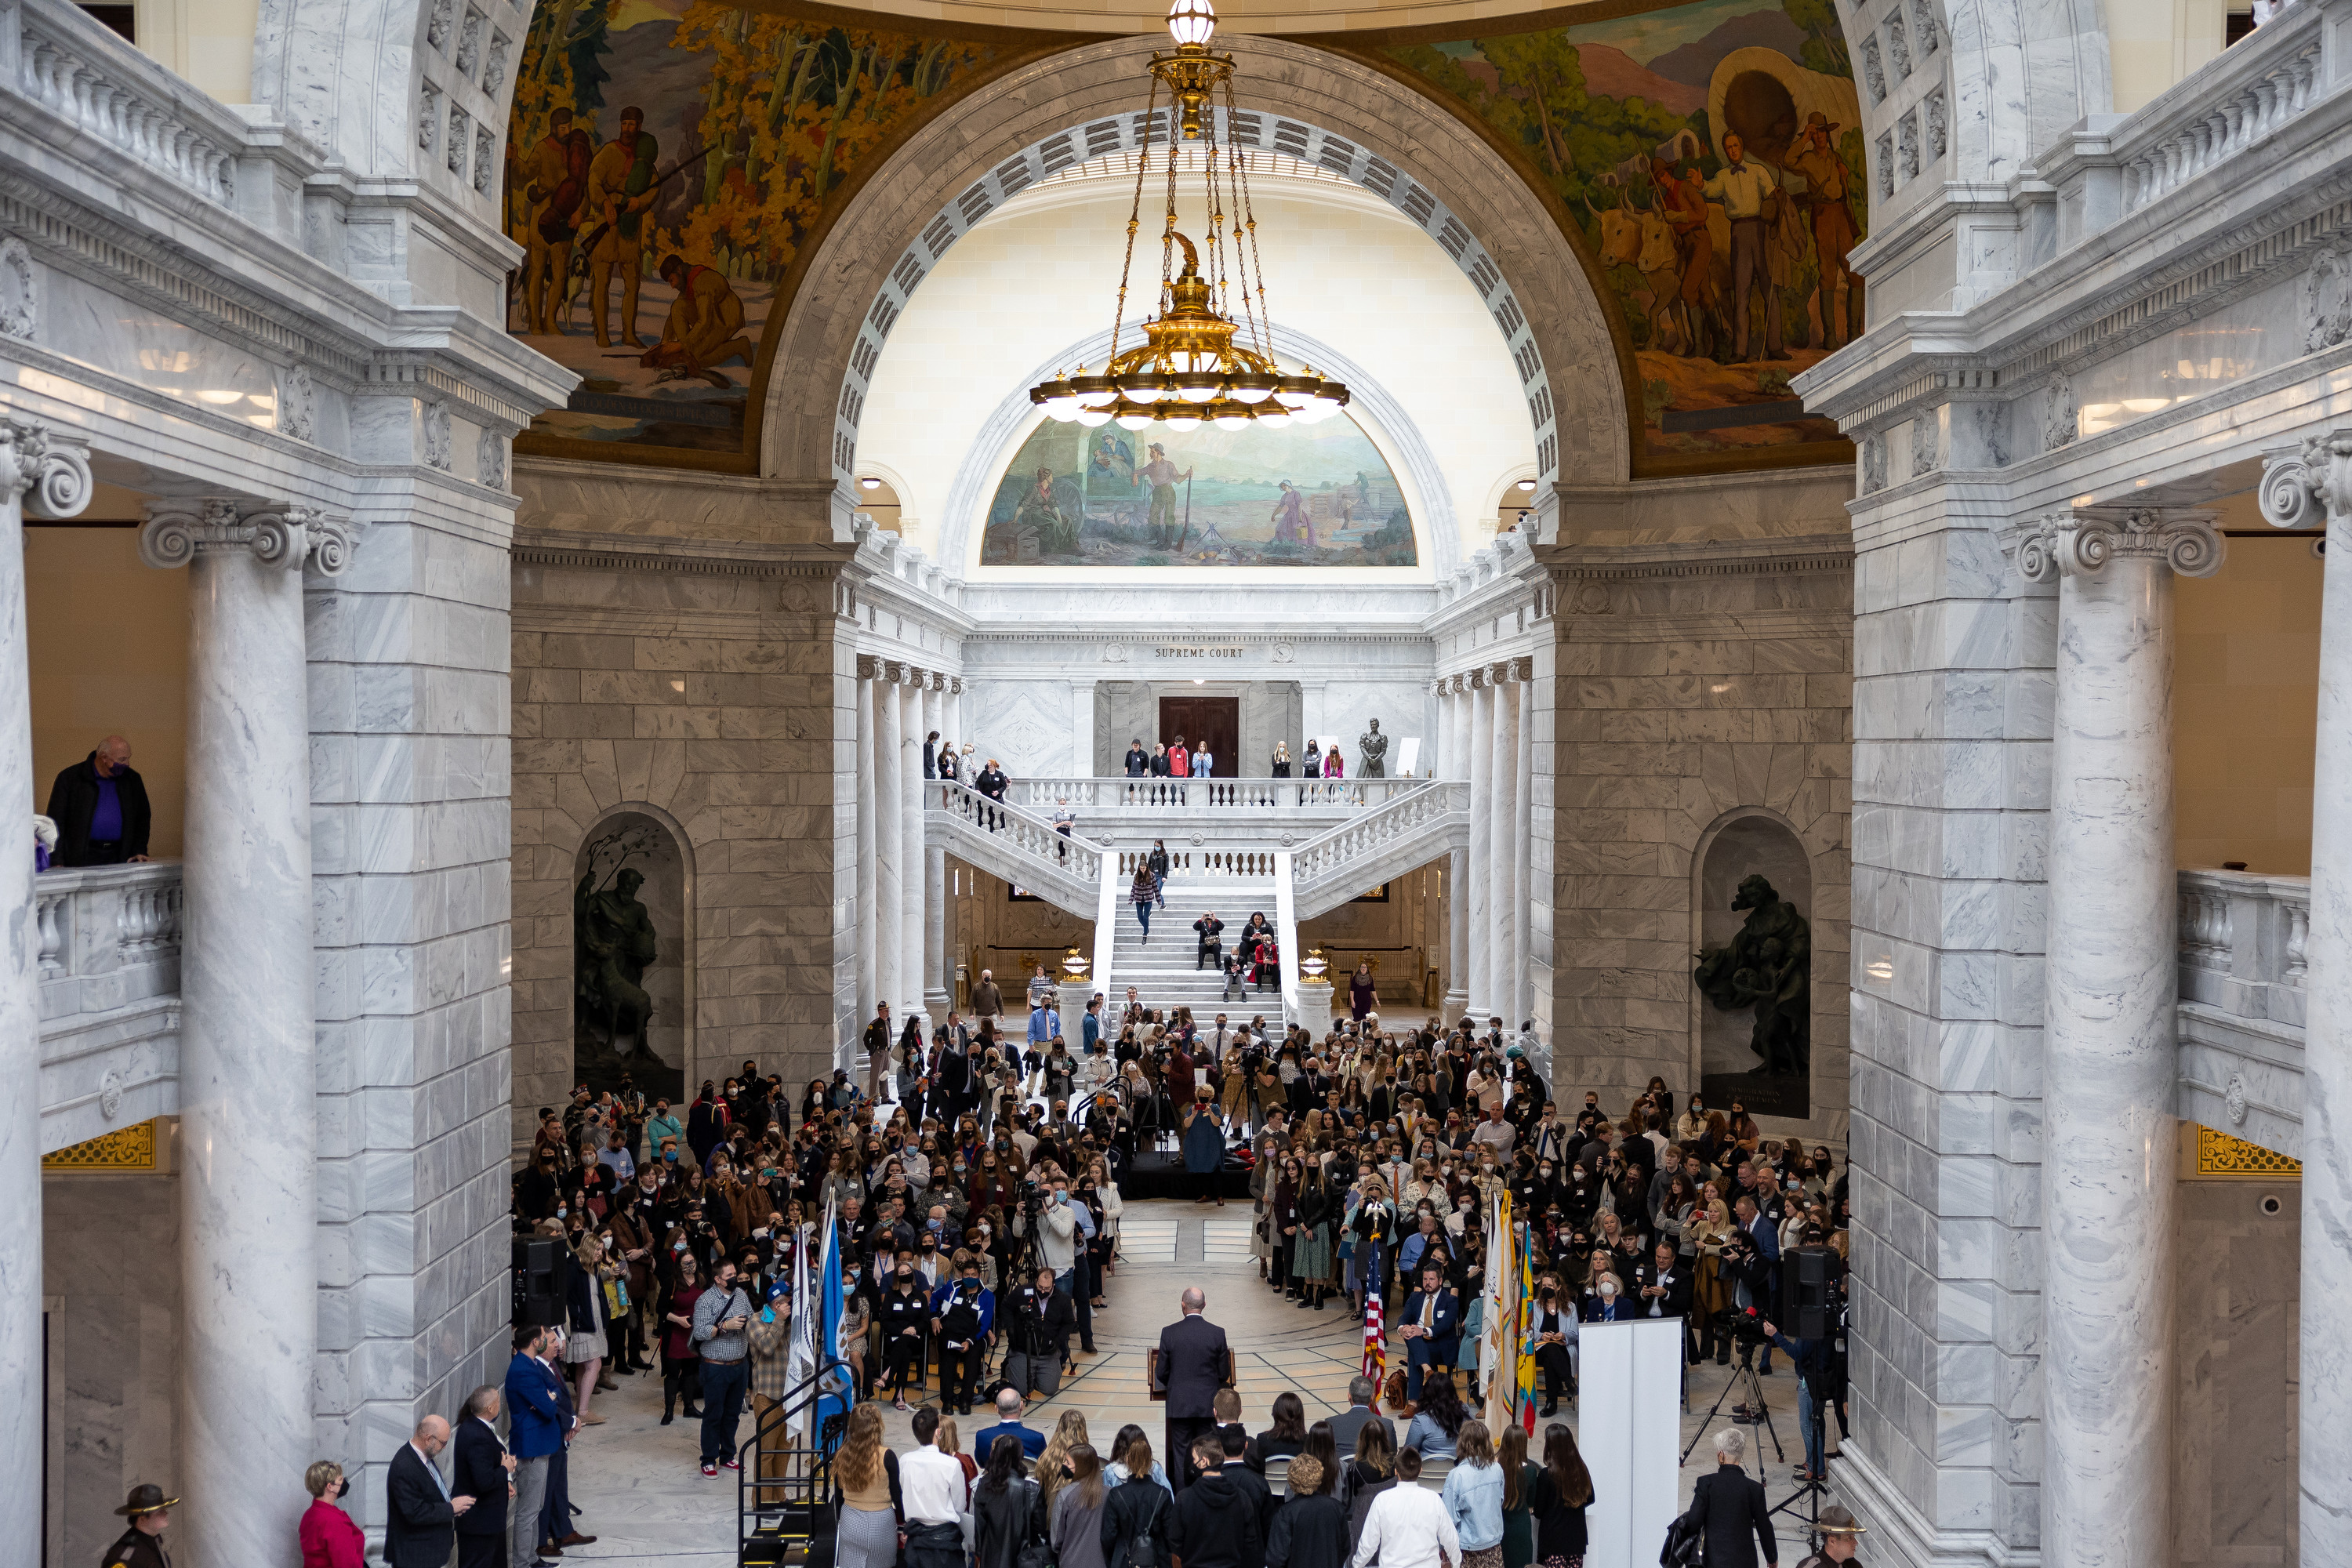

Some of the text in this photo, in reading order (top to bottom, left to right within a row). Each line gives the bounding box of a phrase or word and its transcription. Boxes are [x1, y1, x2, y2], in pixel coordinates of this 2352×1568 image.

[1156, 648, 1243, 657] SUPREME COURT
[1727, 1086, 1780, 1097] IMMIGRATION
